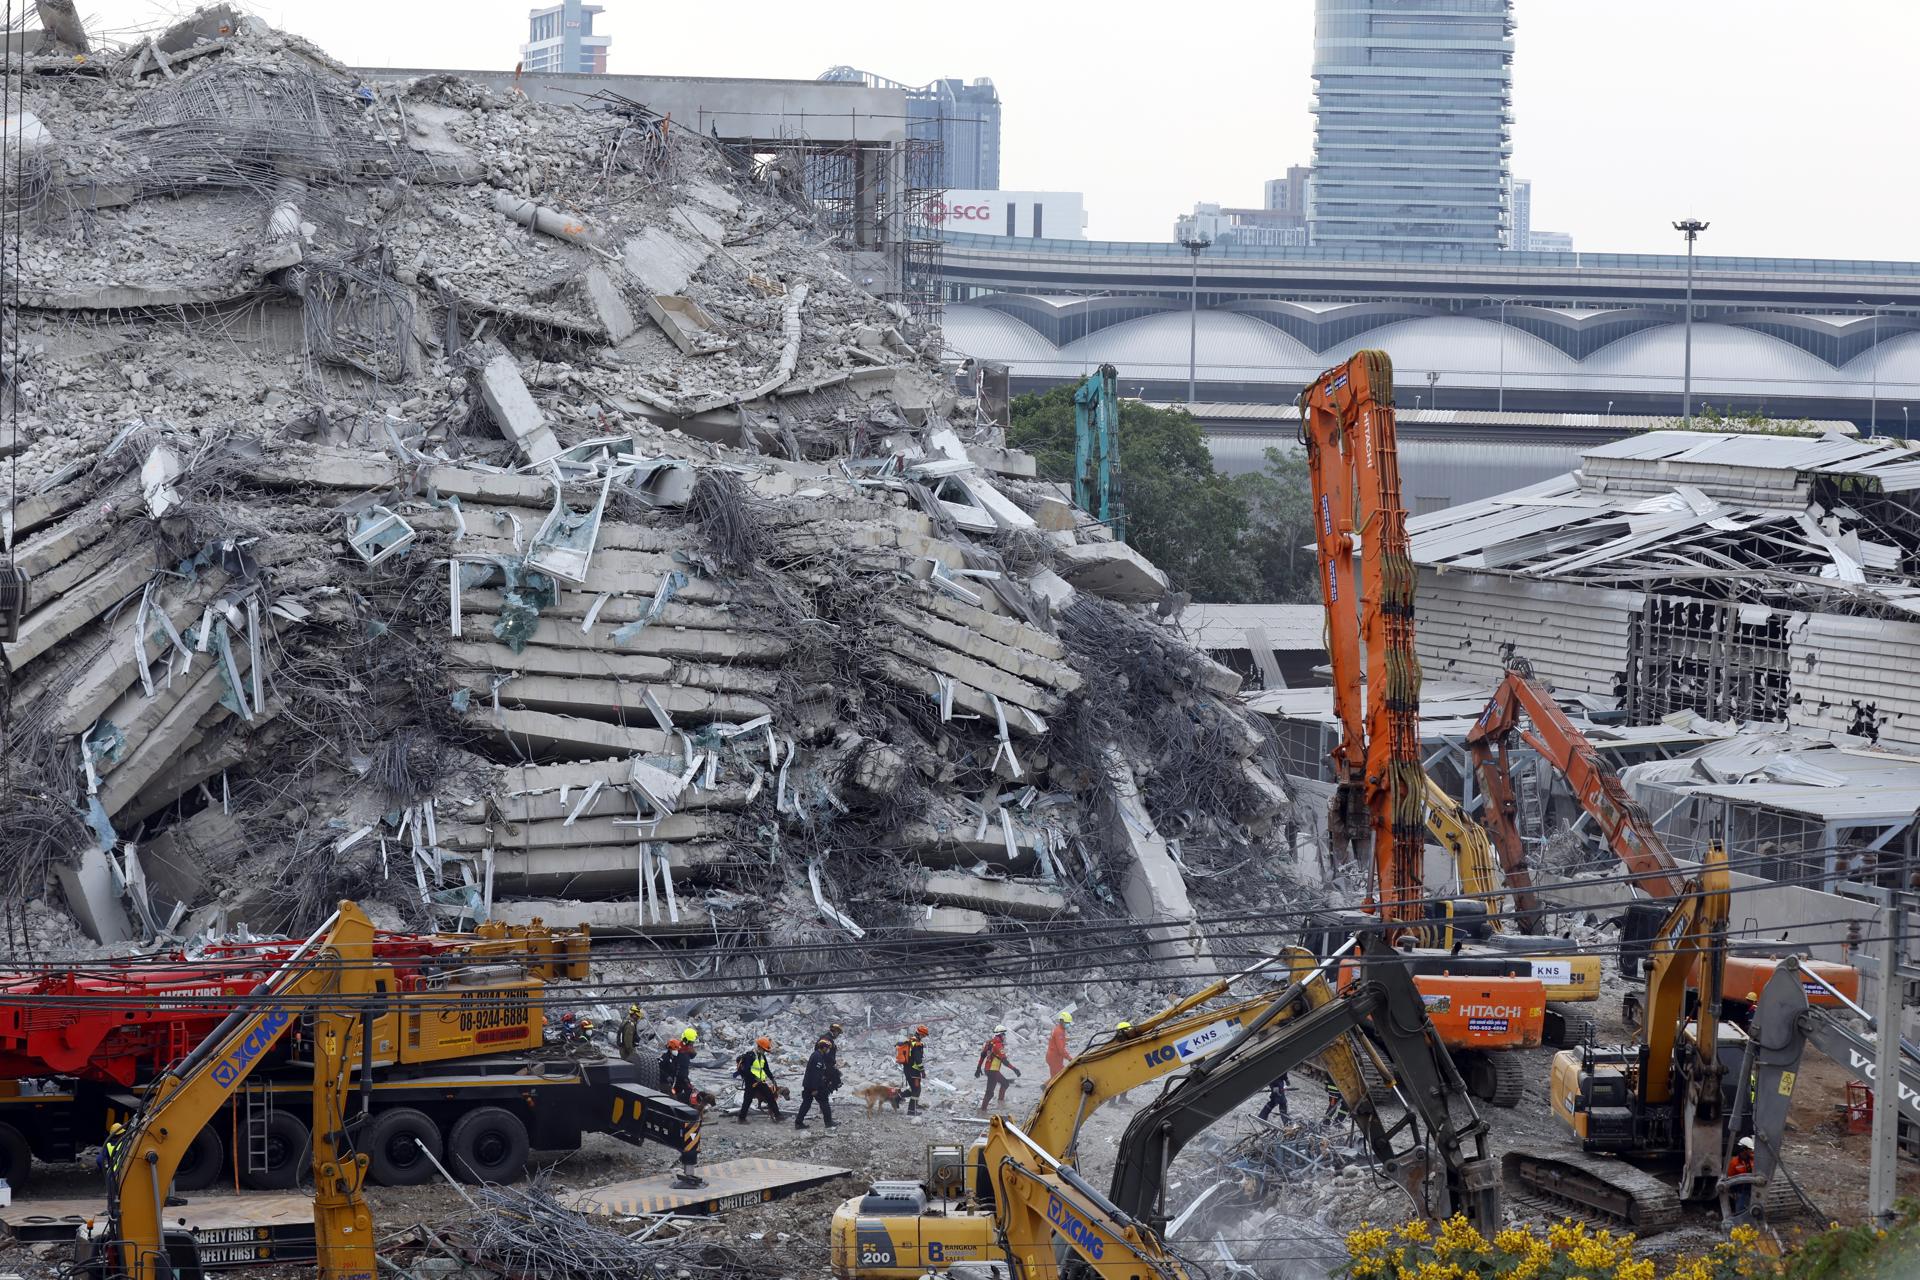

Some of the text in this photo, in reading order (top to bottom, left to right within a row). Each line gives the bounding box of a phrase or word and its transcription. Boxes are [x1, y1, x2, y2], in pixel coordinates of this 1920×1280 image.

[953, 205, 990, 220] SCG
[1363, 412, 1373, 468] HITACHI
[1537, 967, 1559, 975] KNS
[459, 1008, 529, 1031] 08-9244-6884
[1459, 1005, 1521, 1018] HITACHI
[230, 1005, 289, 1071] XCMG
[1192, 1030, 1217, 1046] KNS
[720, 1195, 742, 1211] SAFETY
[228, 1227, 255, 1241] FIRST
[1061, 1210, 1104, 1260] XCMG
[200, 1246, 256, 1262] AFETY FIRST
[862, 1252, 890, 1263] 200
